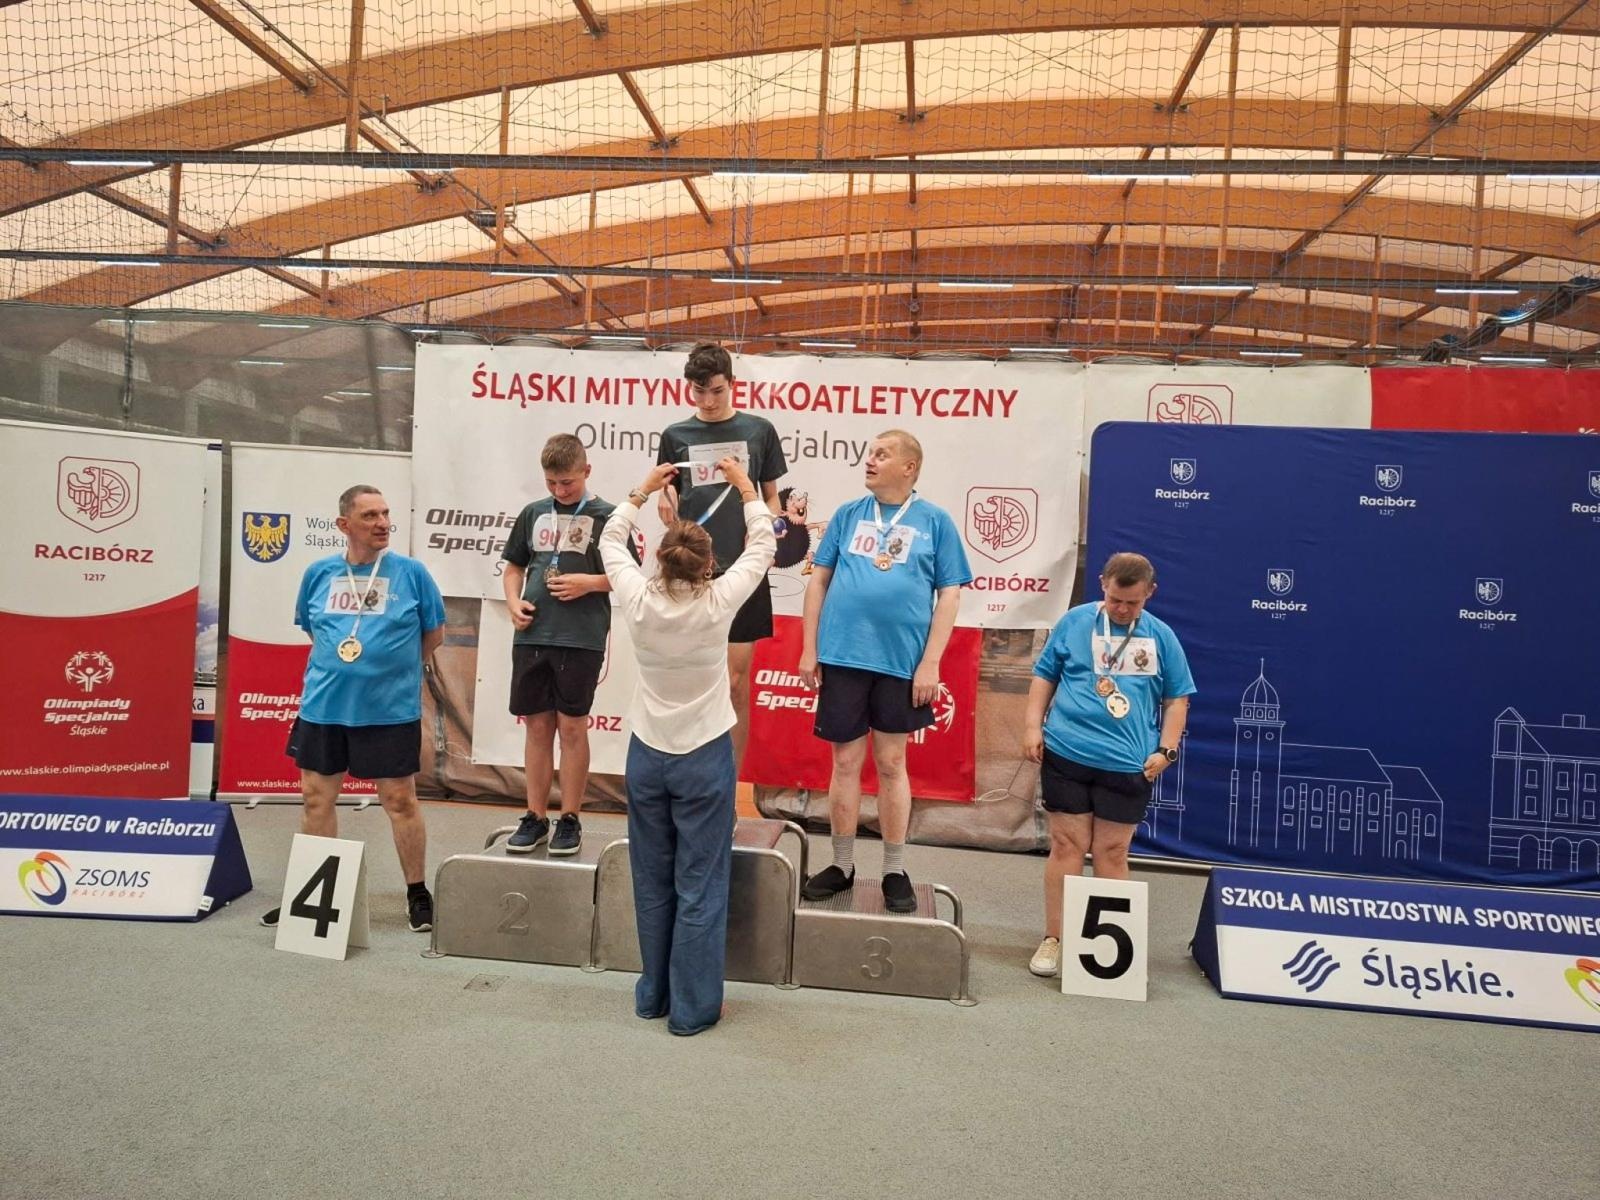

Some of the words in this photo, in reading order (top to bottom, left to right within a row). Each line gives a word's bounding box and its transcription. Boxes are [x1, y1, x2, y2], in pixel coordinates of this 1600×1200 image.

[472, 362, 576, 408] ŚLĄSKI
[732, 380, 1018, 418] EKKOATLETYCZNY
[575, 421, 662, 458] Olimp
[779, 429, 867, 467] cjalny
[1155, 488, 1210, 500] Racibórz
[1359, 496, 1416, 508] Racibórz
[1571, 503, 1600, 514] Raci
[425, 508, 516, 531] Olimpia
[34, 544, 154, 563] RACIBÓRZ
[427, 533, 506, 556] Specja
[83, 573, 106, 582] 1217
[987, 603, 1006, 612] 1217
[1251, 599, 1308, 612] Racibórz
[1459, 609, 1517, 622] Racibórz
[43, 698, 131, 711] Olimpiady
[239, 692, 302, 708] Olimpia
[755, 691, 819, 713] Specj
[43, 712, 129, 724] Specjalne
[239, 707, 299, 721] Specja
[69, 725, 108, 737] Śląskie
[0, 761, 170, 776] ww.slaskie.olimpiadyspecjalne.pl
[105, 819, 120, 834] w
[123, 816, 215, 837] Raciborzu
[75, 868, 150, 888] ZSOMS
[290, 855, 340, 938] 4
[497, 892, 530, 936] 2
[1221, 886, 1305, 912] SZKOŁA
[1310, 894, 1470, 926] MISTRZOSTWA
[1473, 907, 1600, 937] SPORTOWE
[1078, 895, 1134, 980] 5
[861, 936, 895, 980] 3
[1361, 947, 1514, 999] Śląskie.
